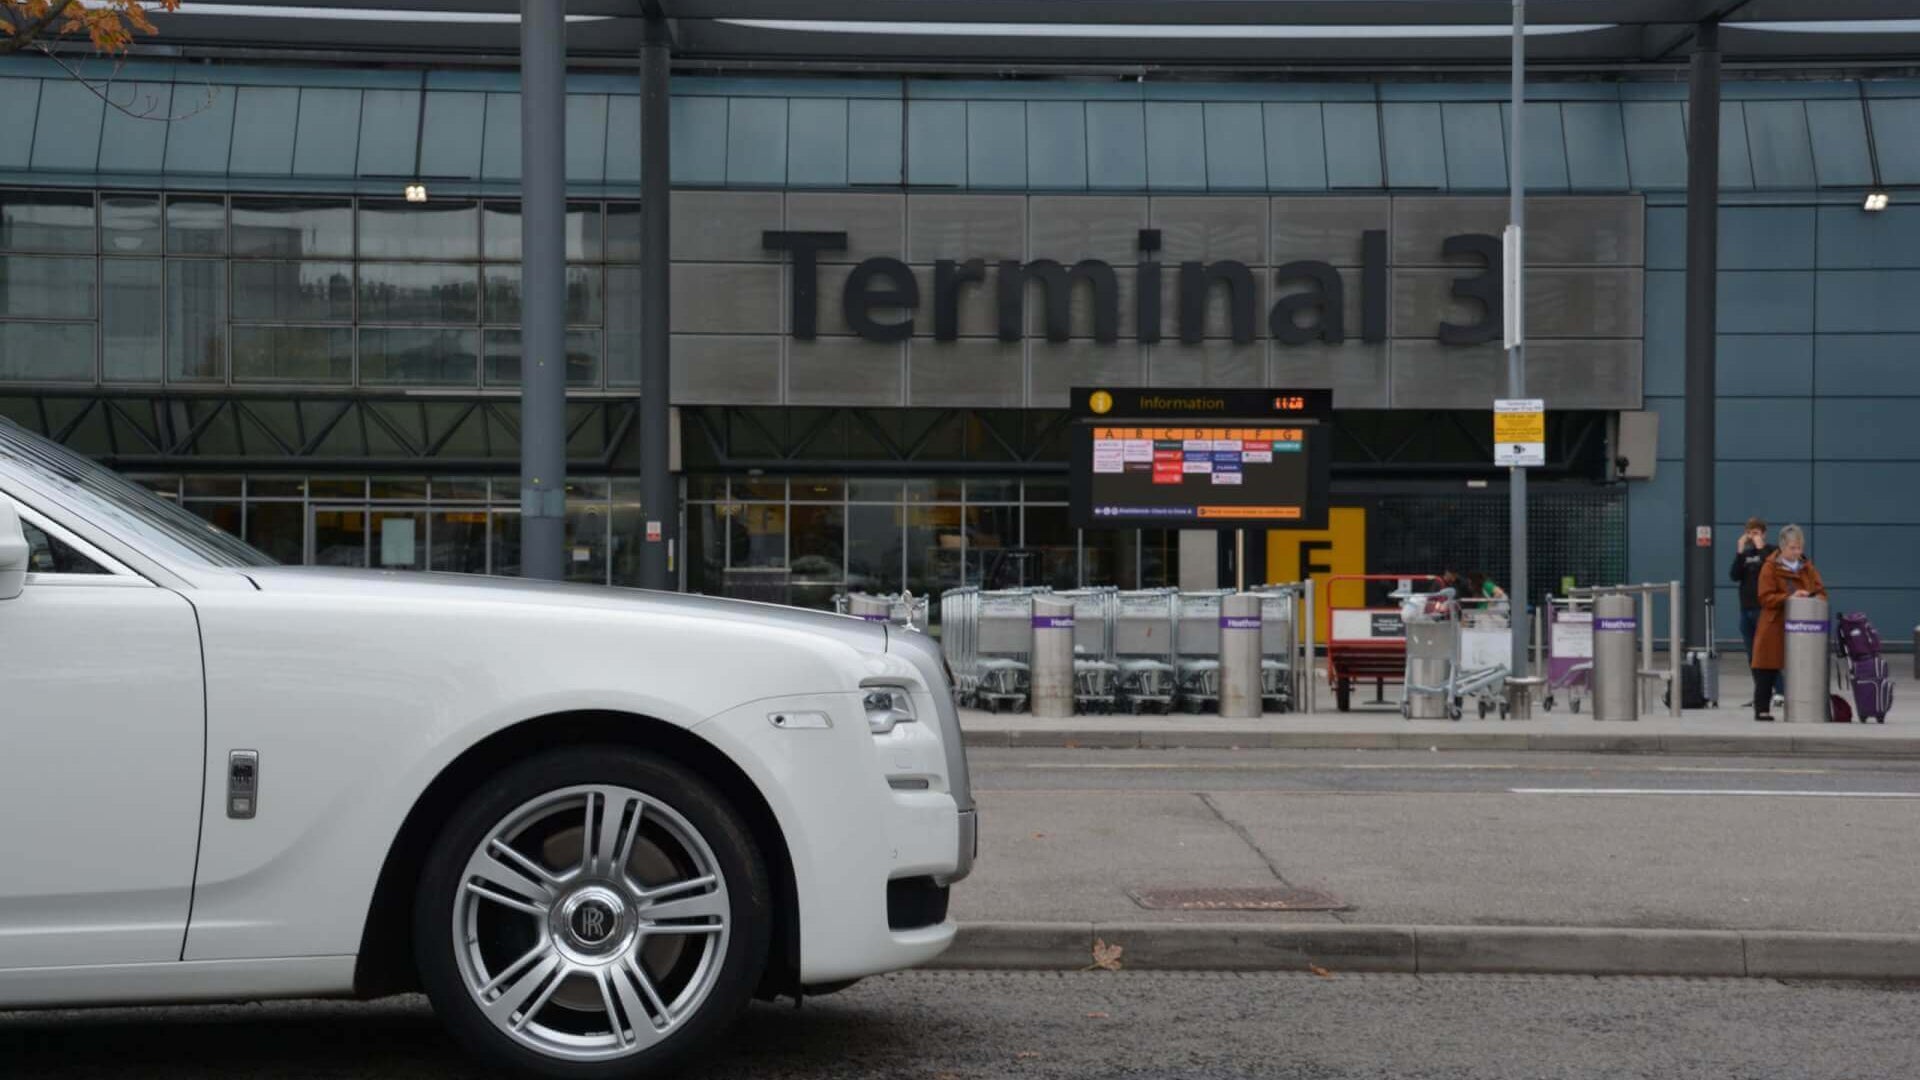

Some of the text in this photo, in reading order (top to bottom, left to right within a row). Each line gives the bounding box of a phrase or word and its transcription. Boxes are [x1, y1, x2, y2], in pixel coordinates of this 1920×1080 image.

[762, 229, 1503, 345] Terminal 3
[1139, 395, 1225, 410] Information
[1105, 429, 1114, 440] A
[1135, 429, 1143, 440] B
[1165, 429, 1174, 440] C
[1195, 429, 1203, 440] D
[1224, 429, 1231, 440] E
[1283, 430, 1292, 440] G
[1299, 541, 1332, 592] F
